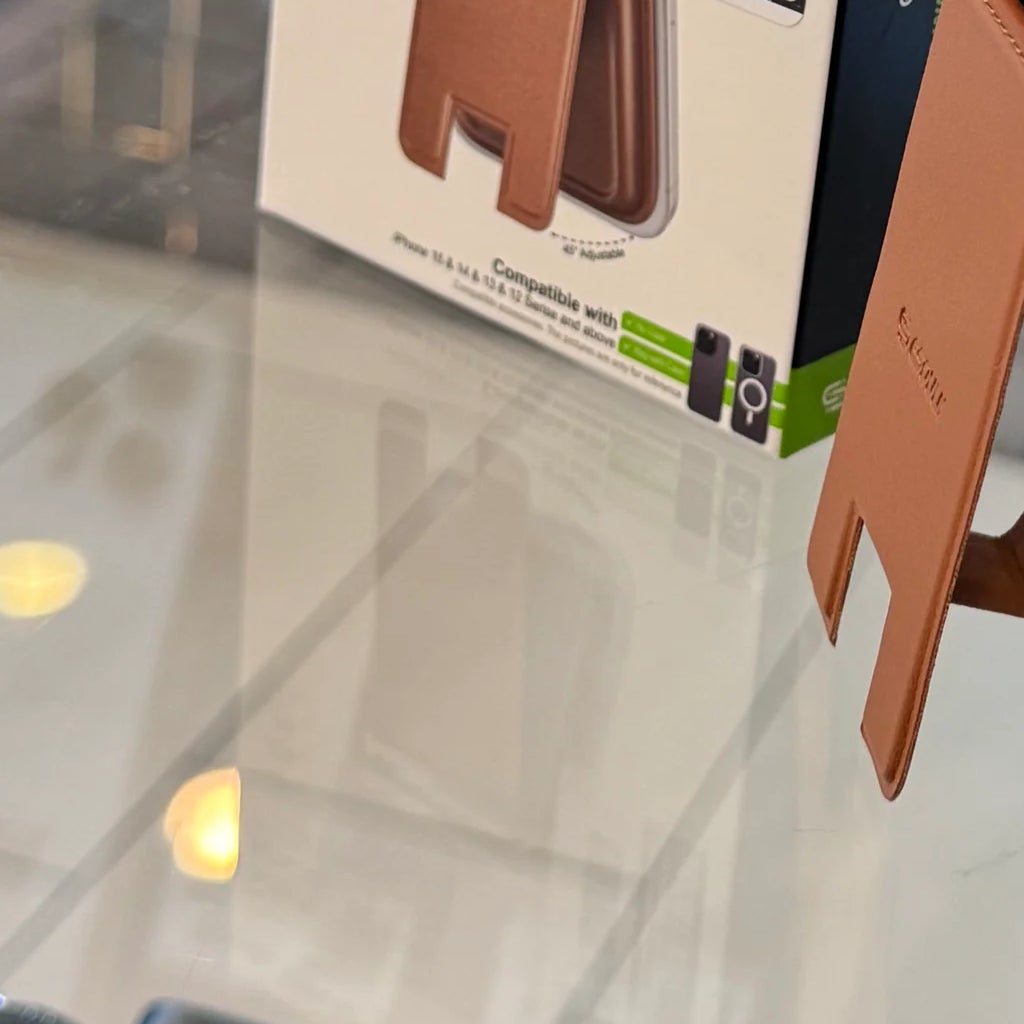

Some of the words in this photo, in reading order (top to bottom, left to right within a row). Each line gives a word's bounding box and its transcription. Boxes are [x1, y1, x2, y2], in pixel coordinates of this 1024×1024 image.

[492, 257, 581, 313] Compatible
[583, 304, 618, 331] with
[559, 314, 581, 332] and
[582, 324, 618, 349] above
